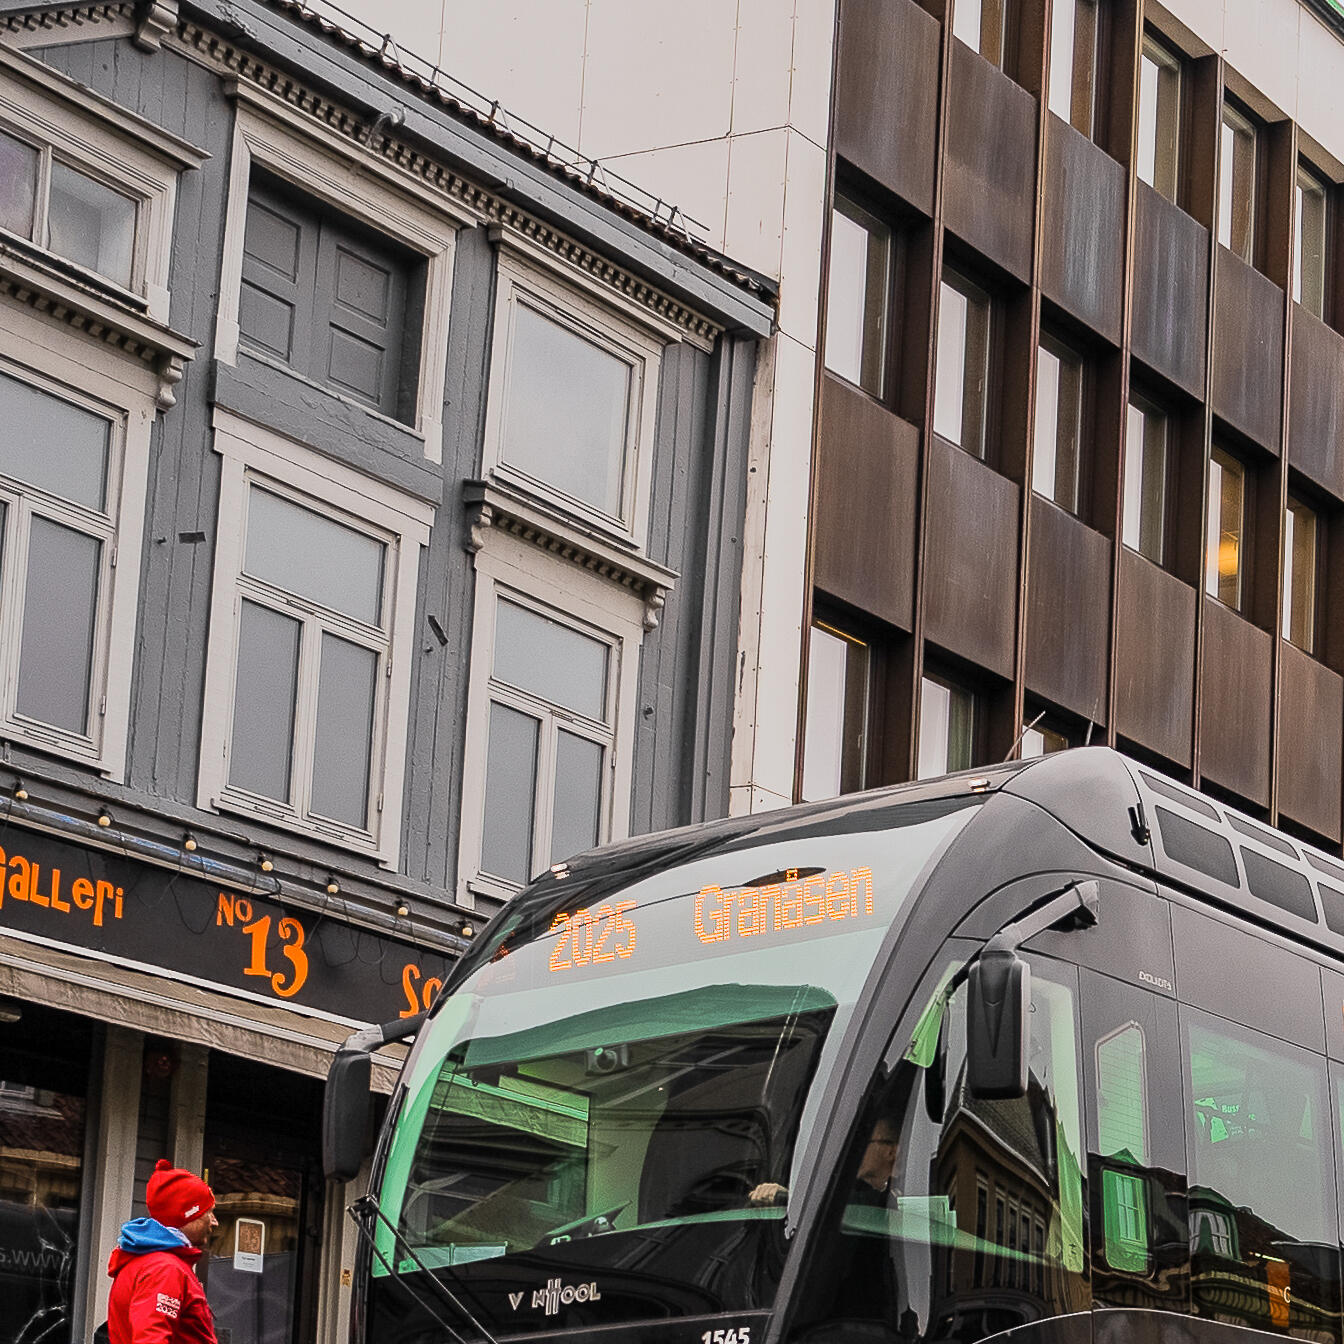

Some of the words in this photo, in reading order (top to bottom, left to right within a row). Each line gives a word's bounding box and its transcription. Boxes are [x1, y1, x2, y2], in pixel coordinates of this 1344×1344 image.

[242, 915, 309, 997] 13
[549, 900, 638, 972] 2025
[694, 866, 874, 943] Granåsen
